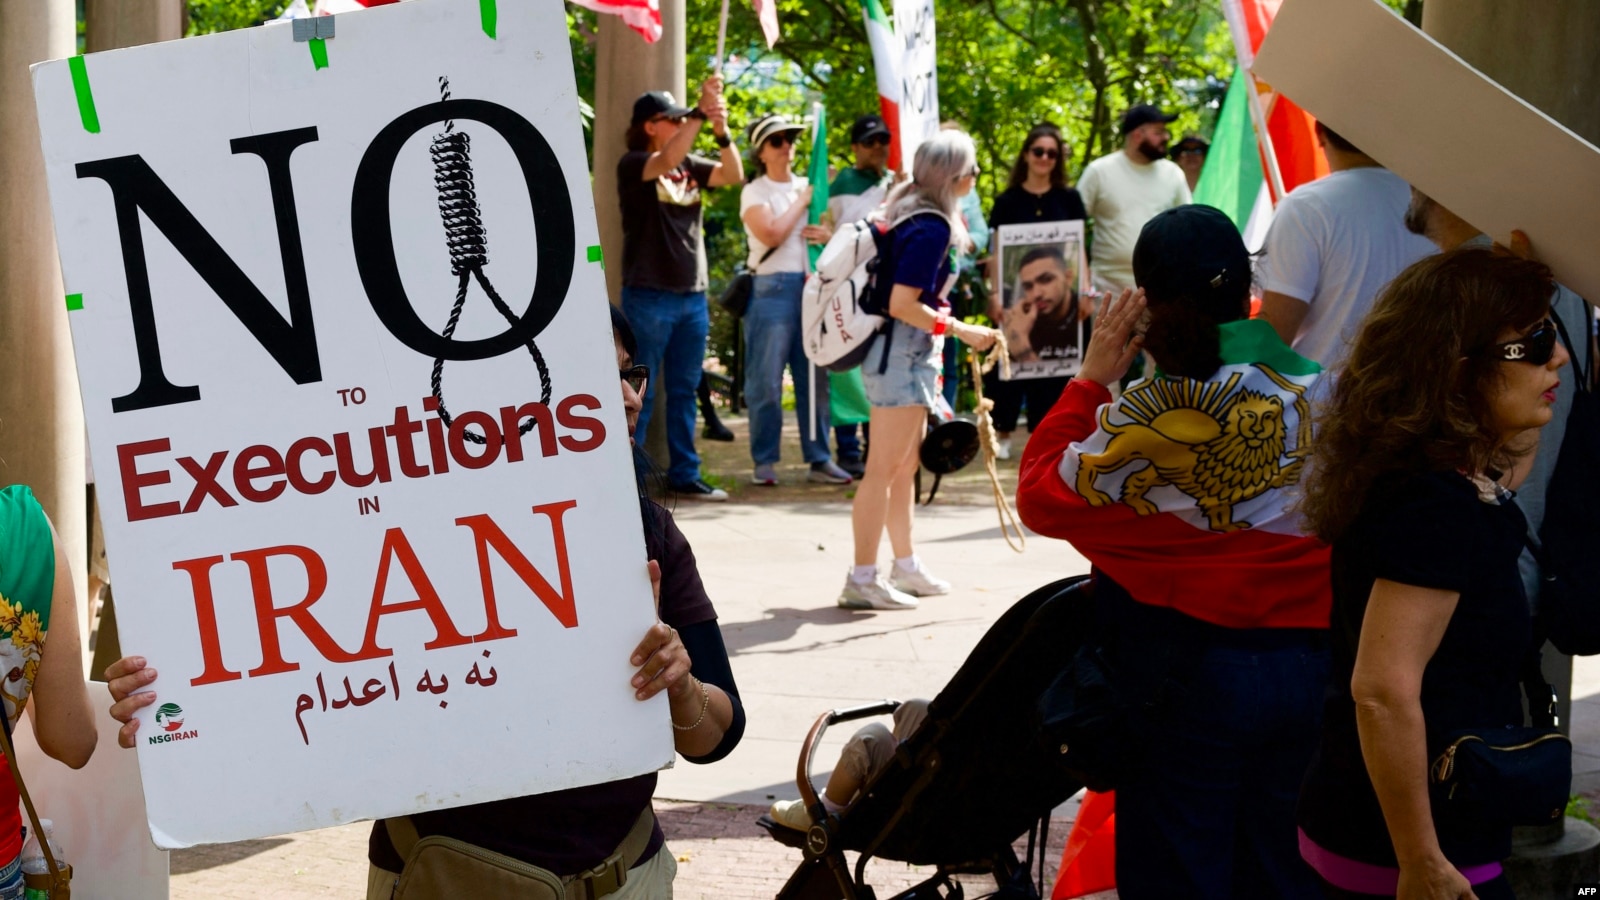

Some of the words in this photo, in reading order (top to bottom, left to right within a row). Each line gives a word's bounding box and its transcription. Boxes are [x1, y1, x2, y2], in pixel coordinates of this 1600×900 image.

[75, 98, 576, 413] NO
[831, 296, 854, 345] USA
[337, 387, 367, 407] TO
[116, 393, 607, 523] Executions
[358, 496, 381, 516] IN
[172, 499, 579, 687] IRAN
[416, 668, 449, 709] به
[464, 649, 498, 688] نه
[295, 660, 400, 746] اعدام
[148, 730, 198, 745] NSGIRAN
